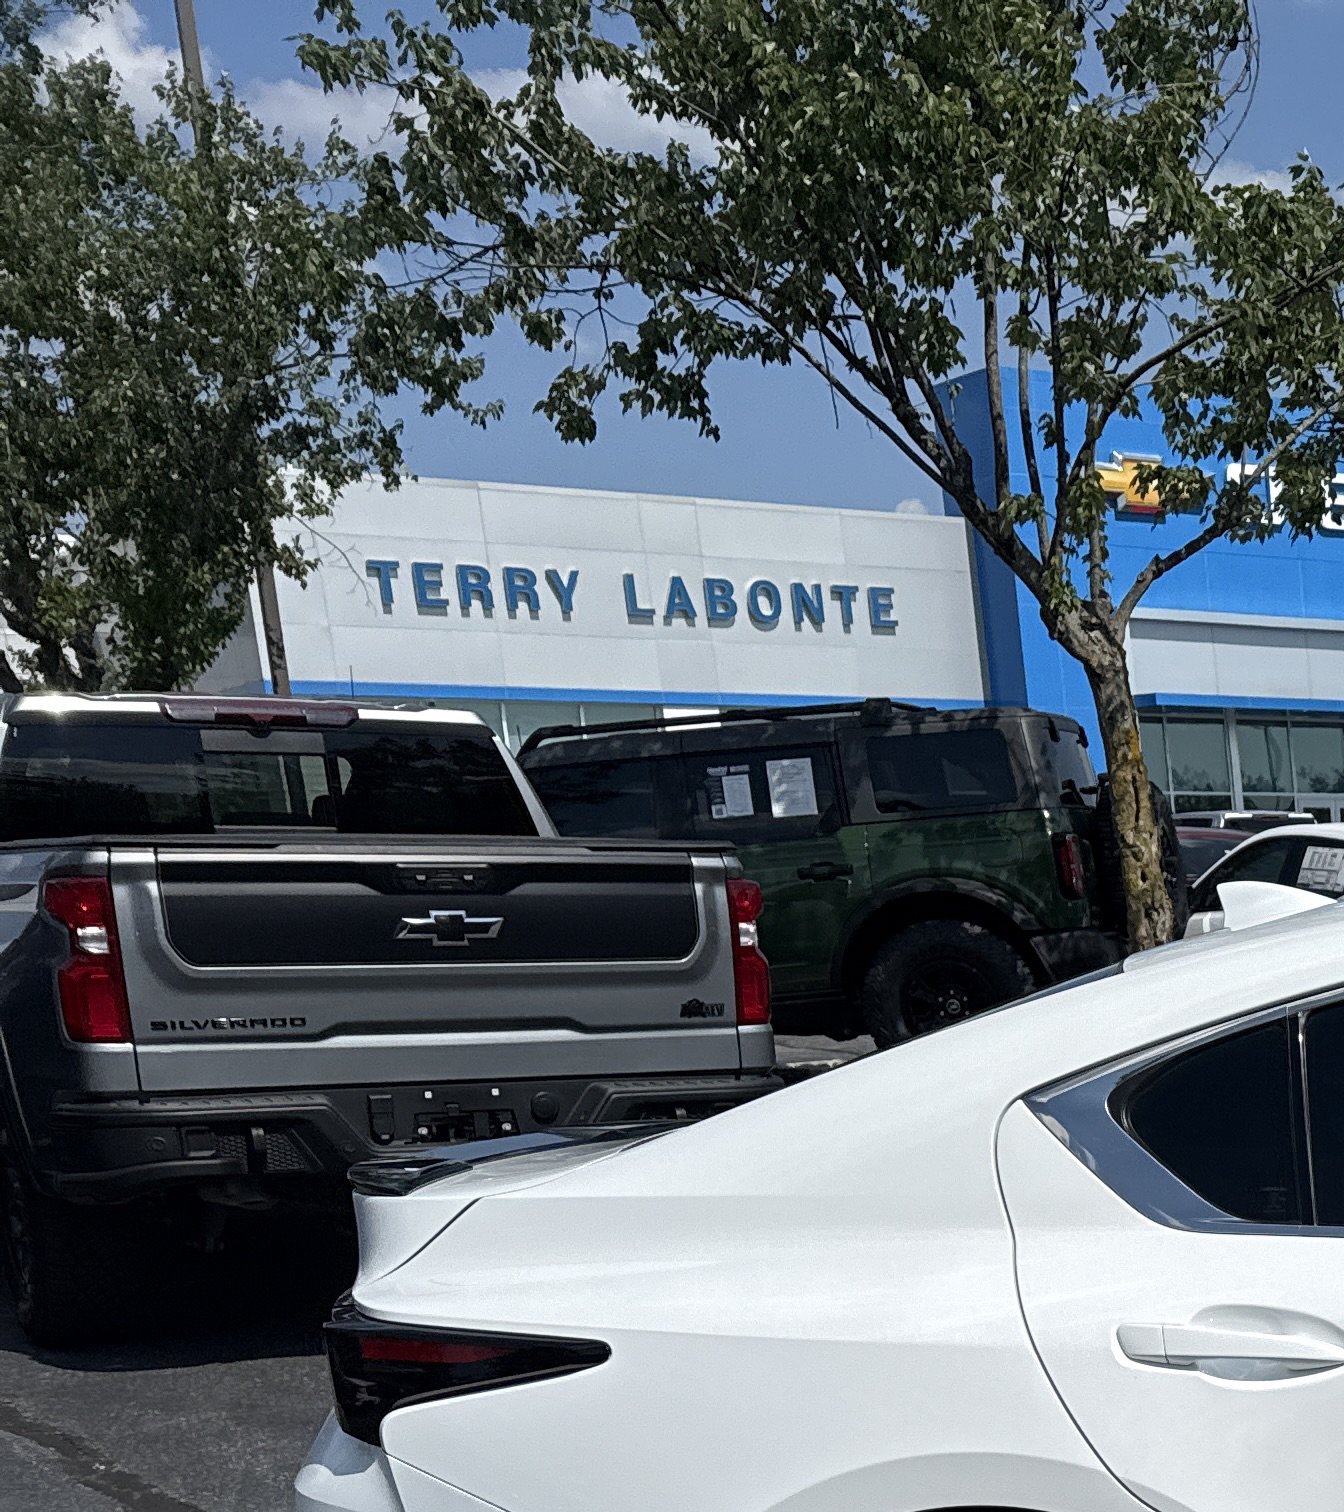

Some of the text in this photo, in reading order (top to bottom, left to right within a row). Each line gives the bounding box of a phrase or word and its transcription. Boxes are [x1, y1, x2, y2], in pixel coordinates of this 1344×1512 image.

[366, 559, 899, 630] TERRY LABONTE
[150, 1017, 306, 1031] SILVERADO
